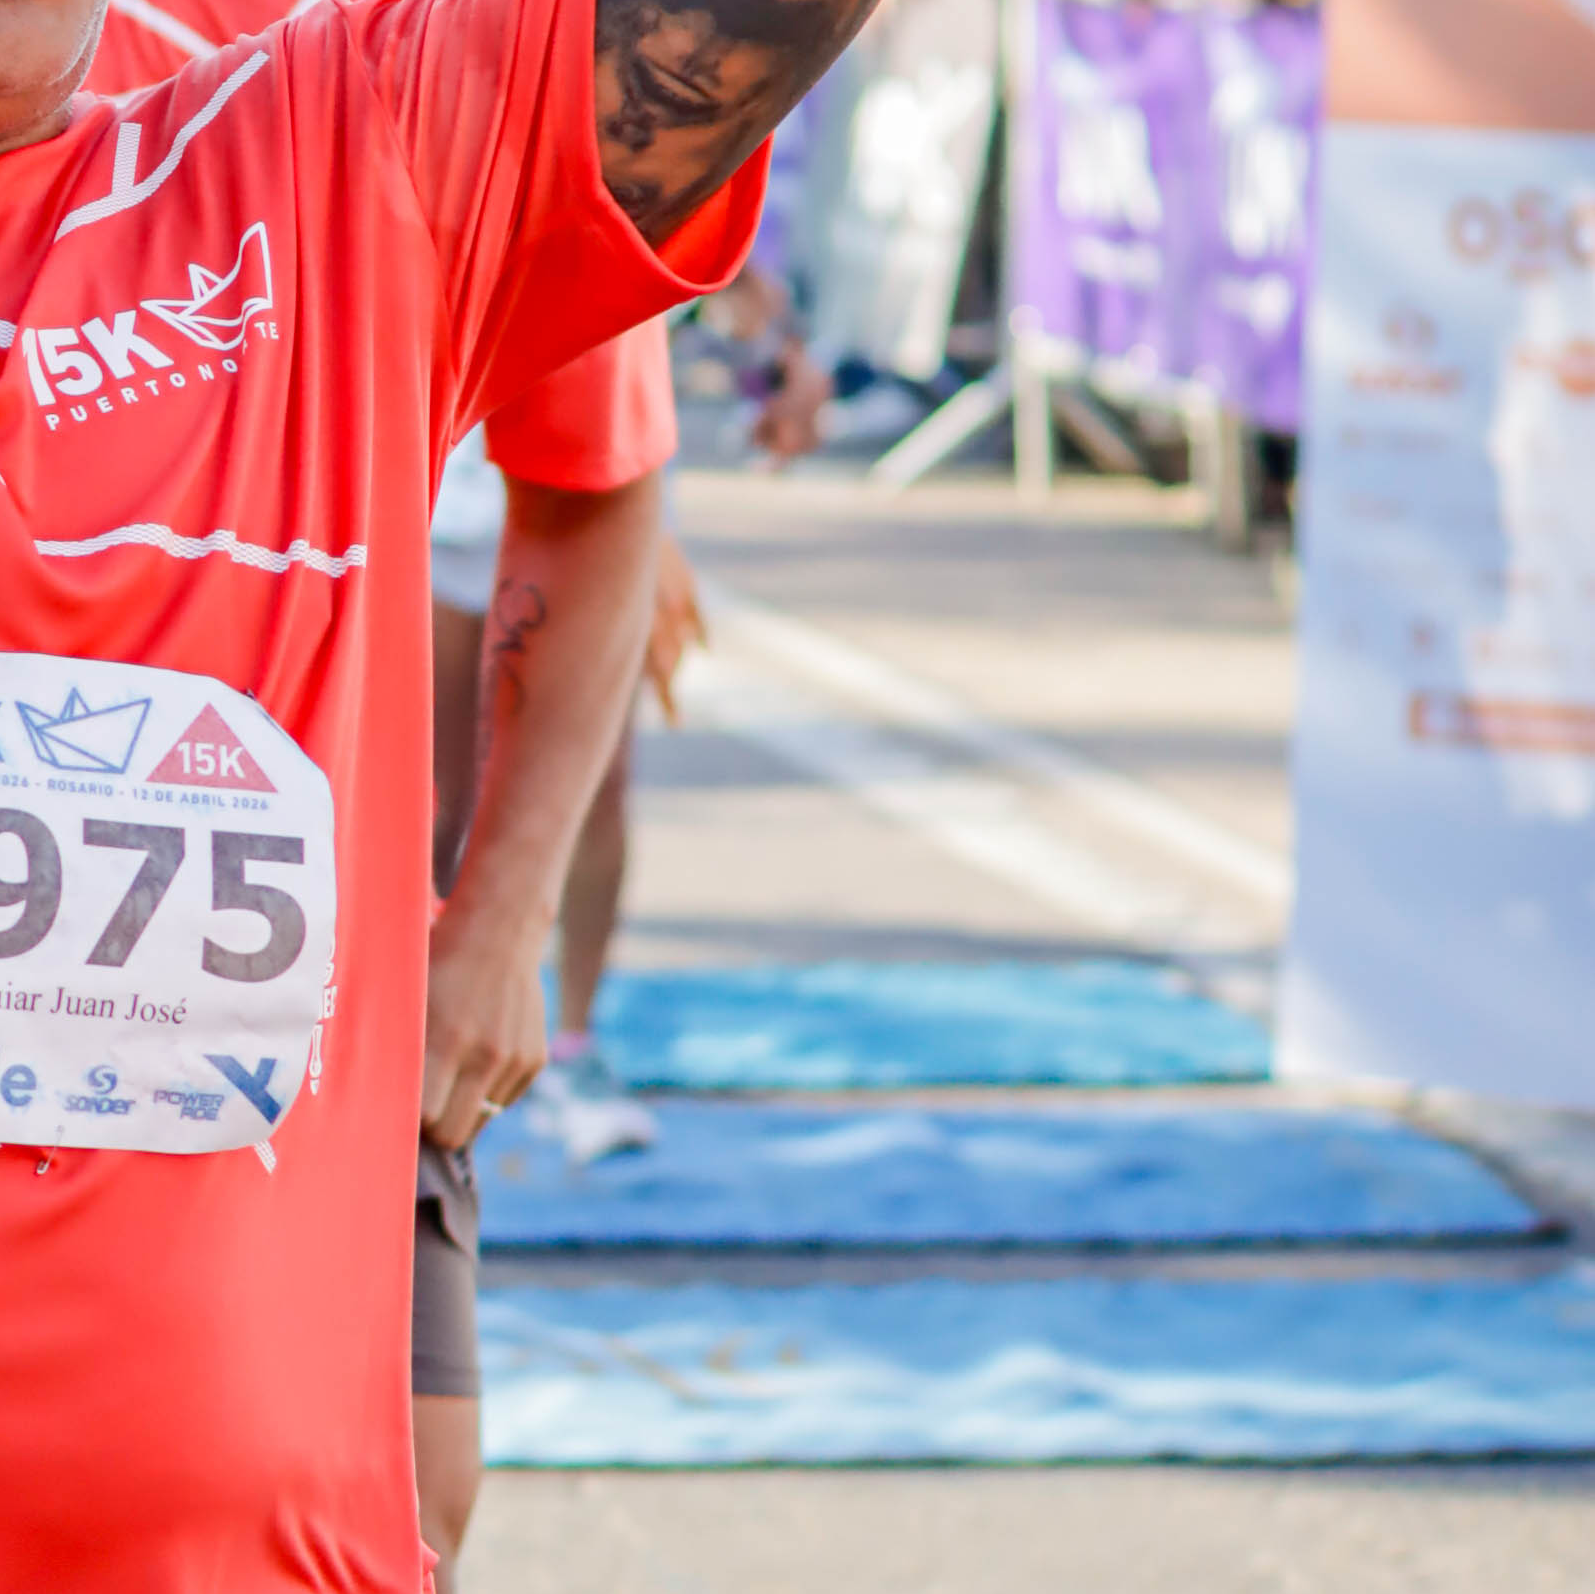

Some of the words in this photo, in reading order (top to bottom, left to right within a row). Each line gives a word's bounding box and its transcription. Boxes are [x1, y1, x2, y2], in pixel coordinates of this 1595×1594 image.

[21, 309, 175, 407] 15K
[45, 372, 187, 431] PUERTO
[176, 741, 247, 779] 15K
[47, 778, 114, 797] ROSARIO
[133, 787, 149, 801] 12
[156, 789, 173, 803] DE
[180, 793, 226, 807] ABRIL
[50, 986, 116, 1019] Juan
[124, 993, 188, 1025] José
[153, 1089, 225, 1109] POWER
